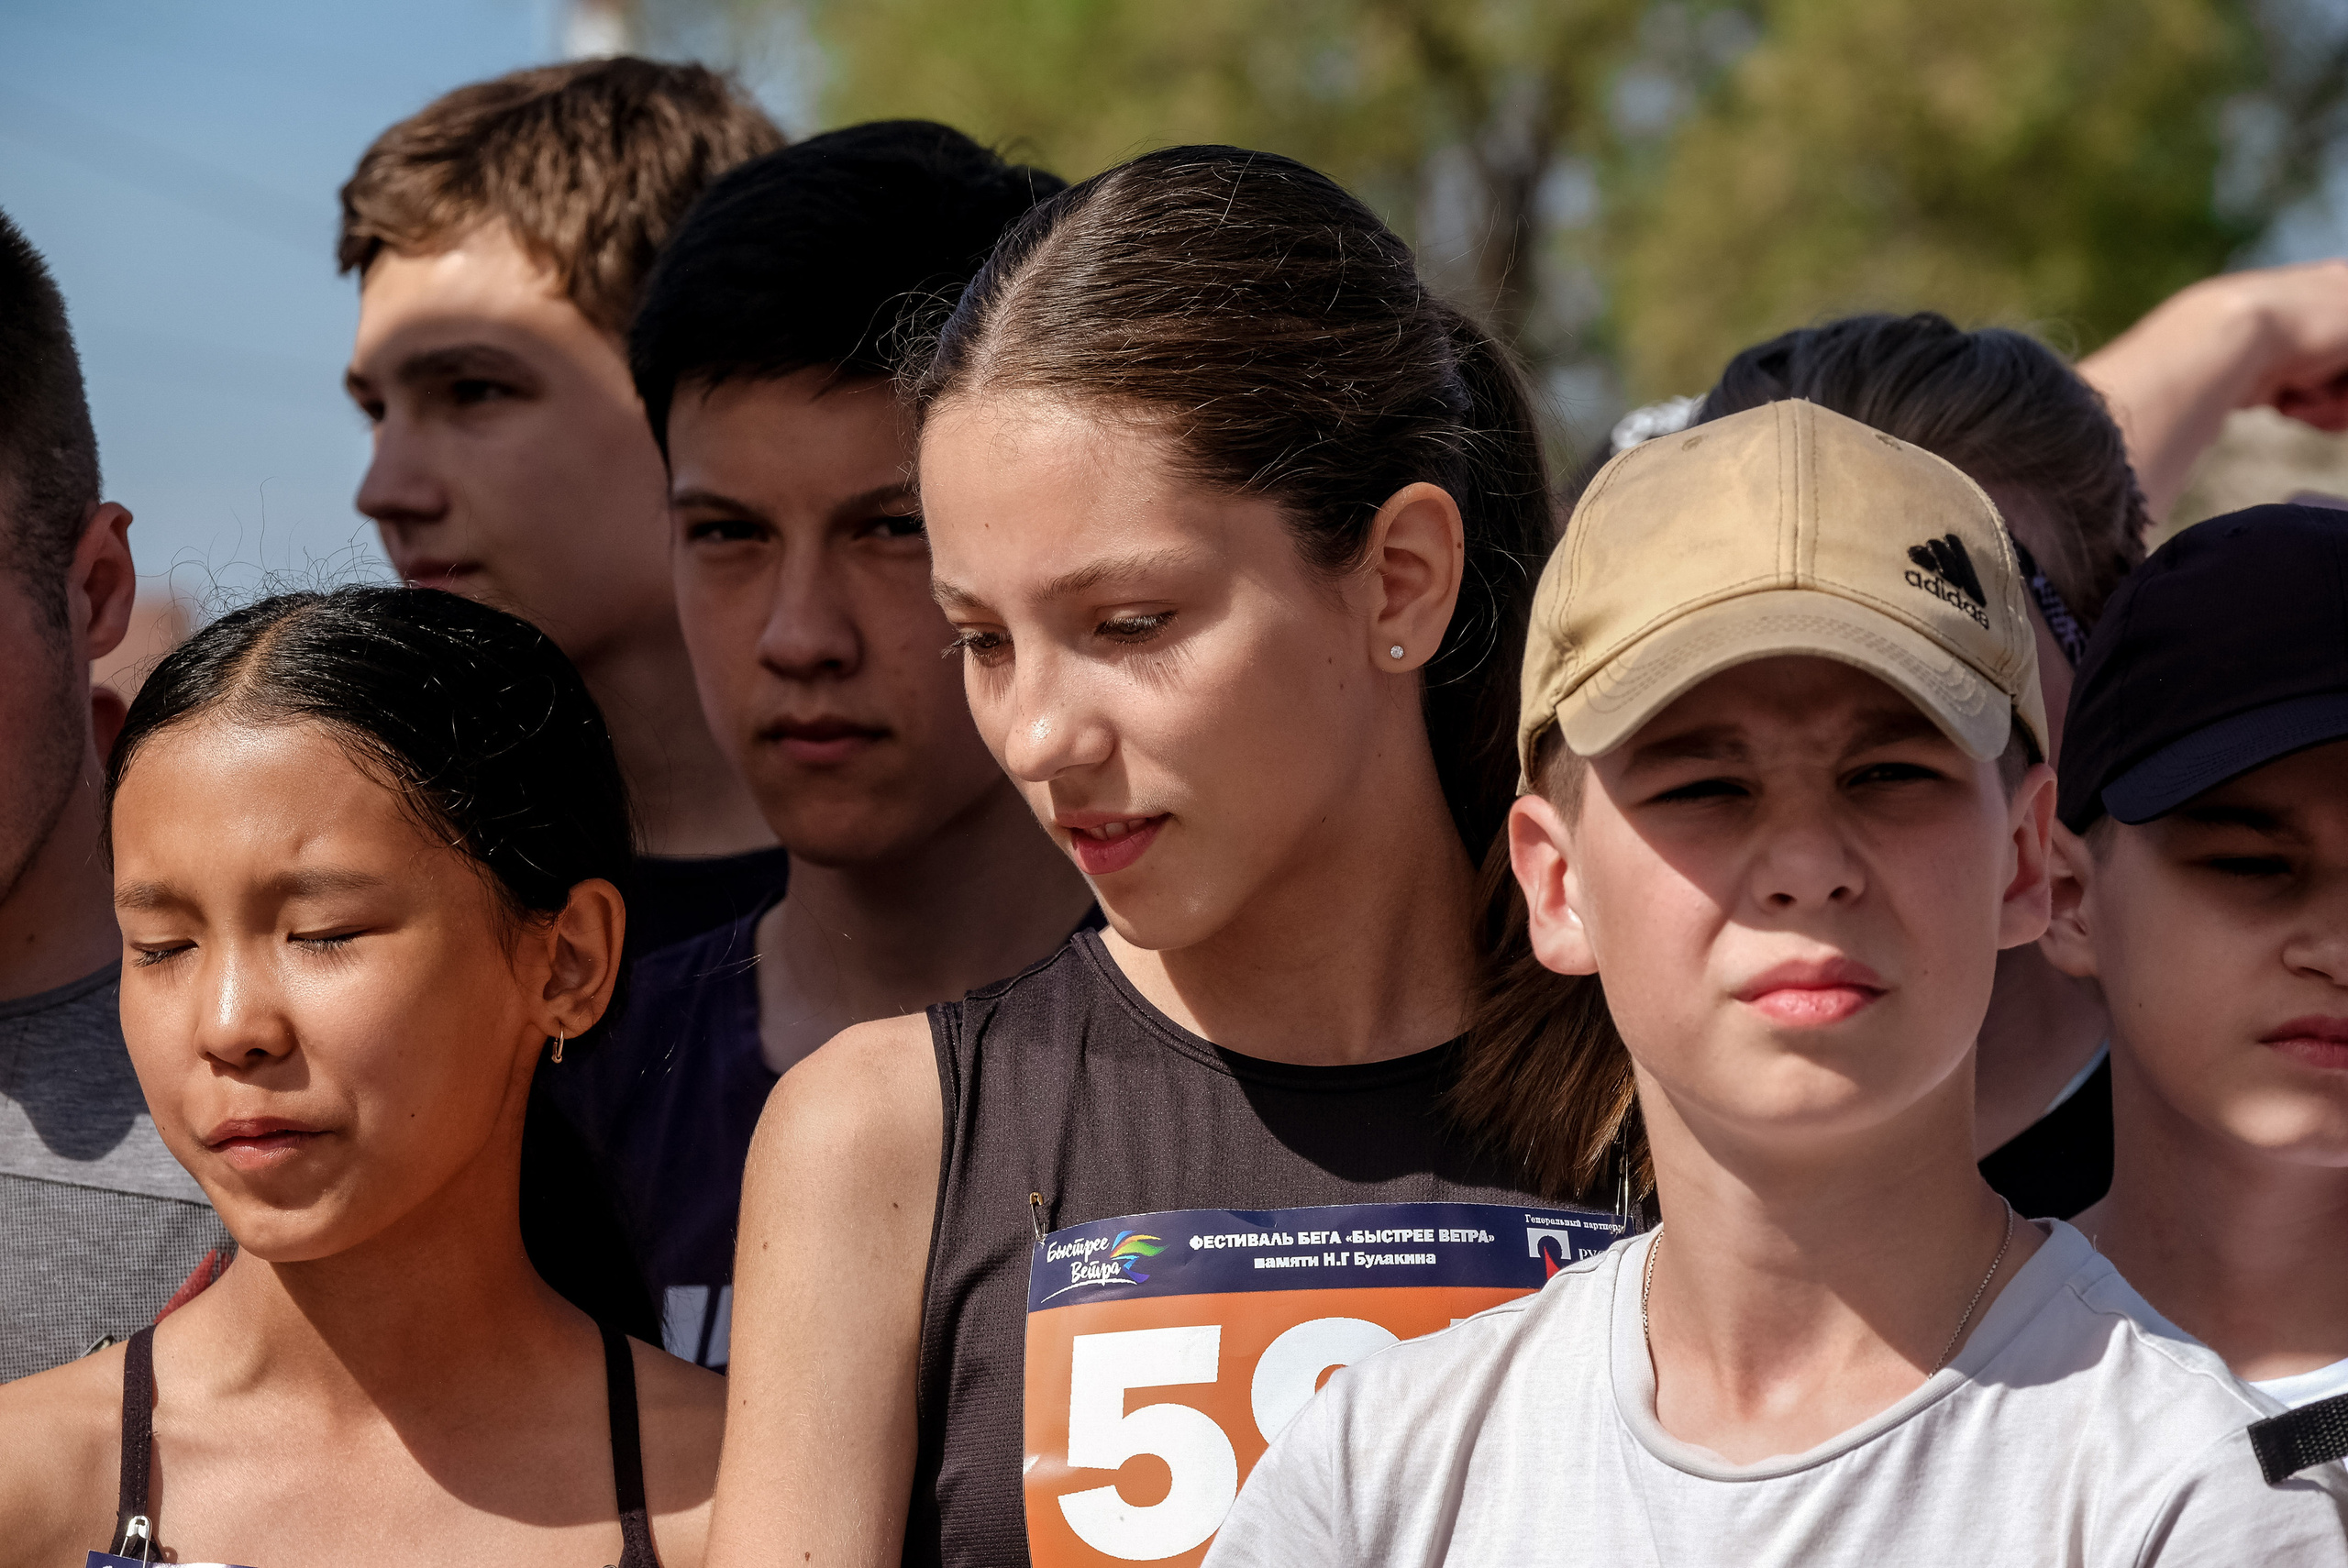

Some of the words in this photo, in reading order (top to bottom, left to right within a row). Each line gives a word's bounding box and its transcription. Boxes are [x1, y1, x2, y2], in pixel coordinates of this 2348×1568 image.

[1904, 569, 1990, 630] adidas
[1524, 1214, 1581, 1228] Генеральный
[1047, 1236, 1110, 1263] Быстрее
[1189, 1232, 1294, 1250] ФЕСТИВАЛЬ
[1297, 1231, 1342, 1245] БЕГА
[1346, 1229, 1434, 1243] «БЫСТРЕЕ
[1438, 1229, 1495, 1243] ВЕТРА»
[1254, 1256, 1319, 1269] памяти
[1323, 1252, 1350, 1266] Н.Г
[1354, 1252, 1436, 1268] Булакина
[1070, 1260, 1122, 1286] Ветра
